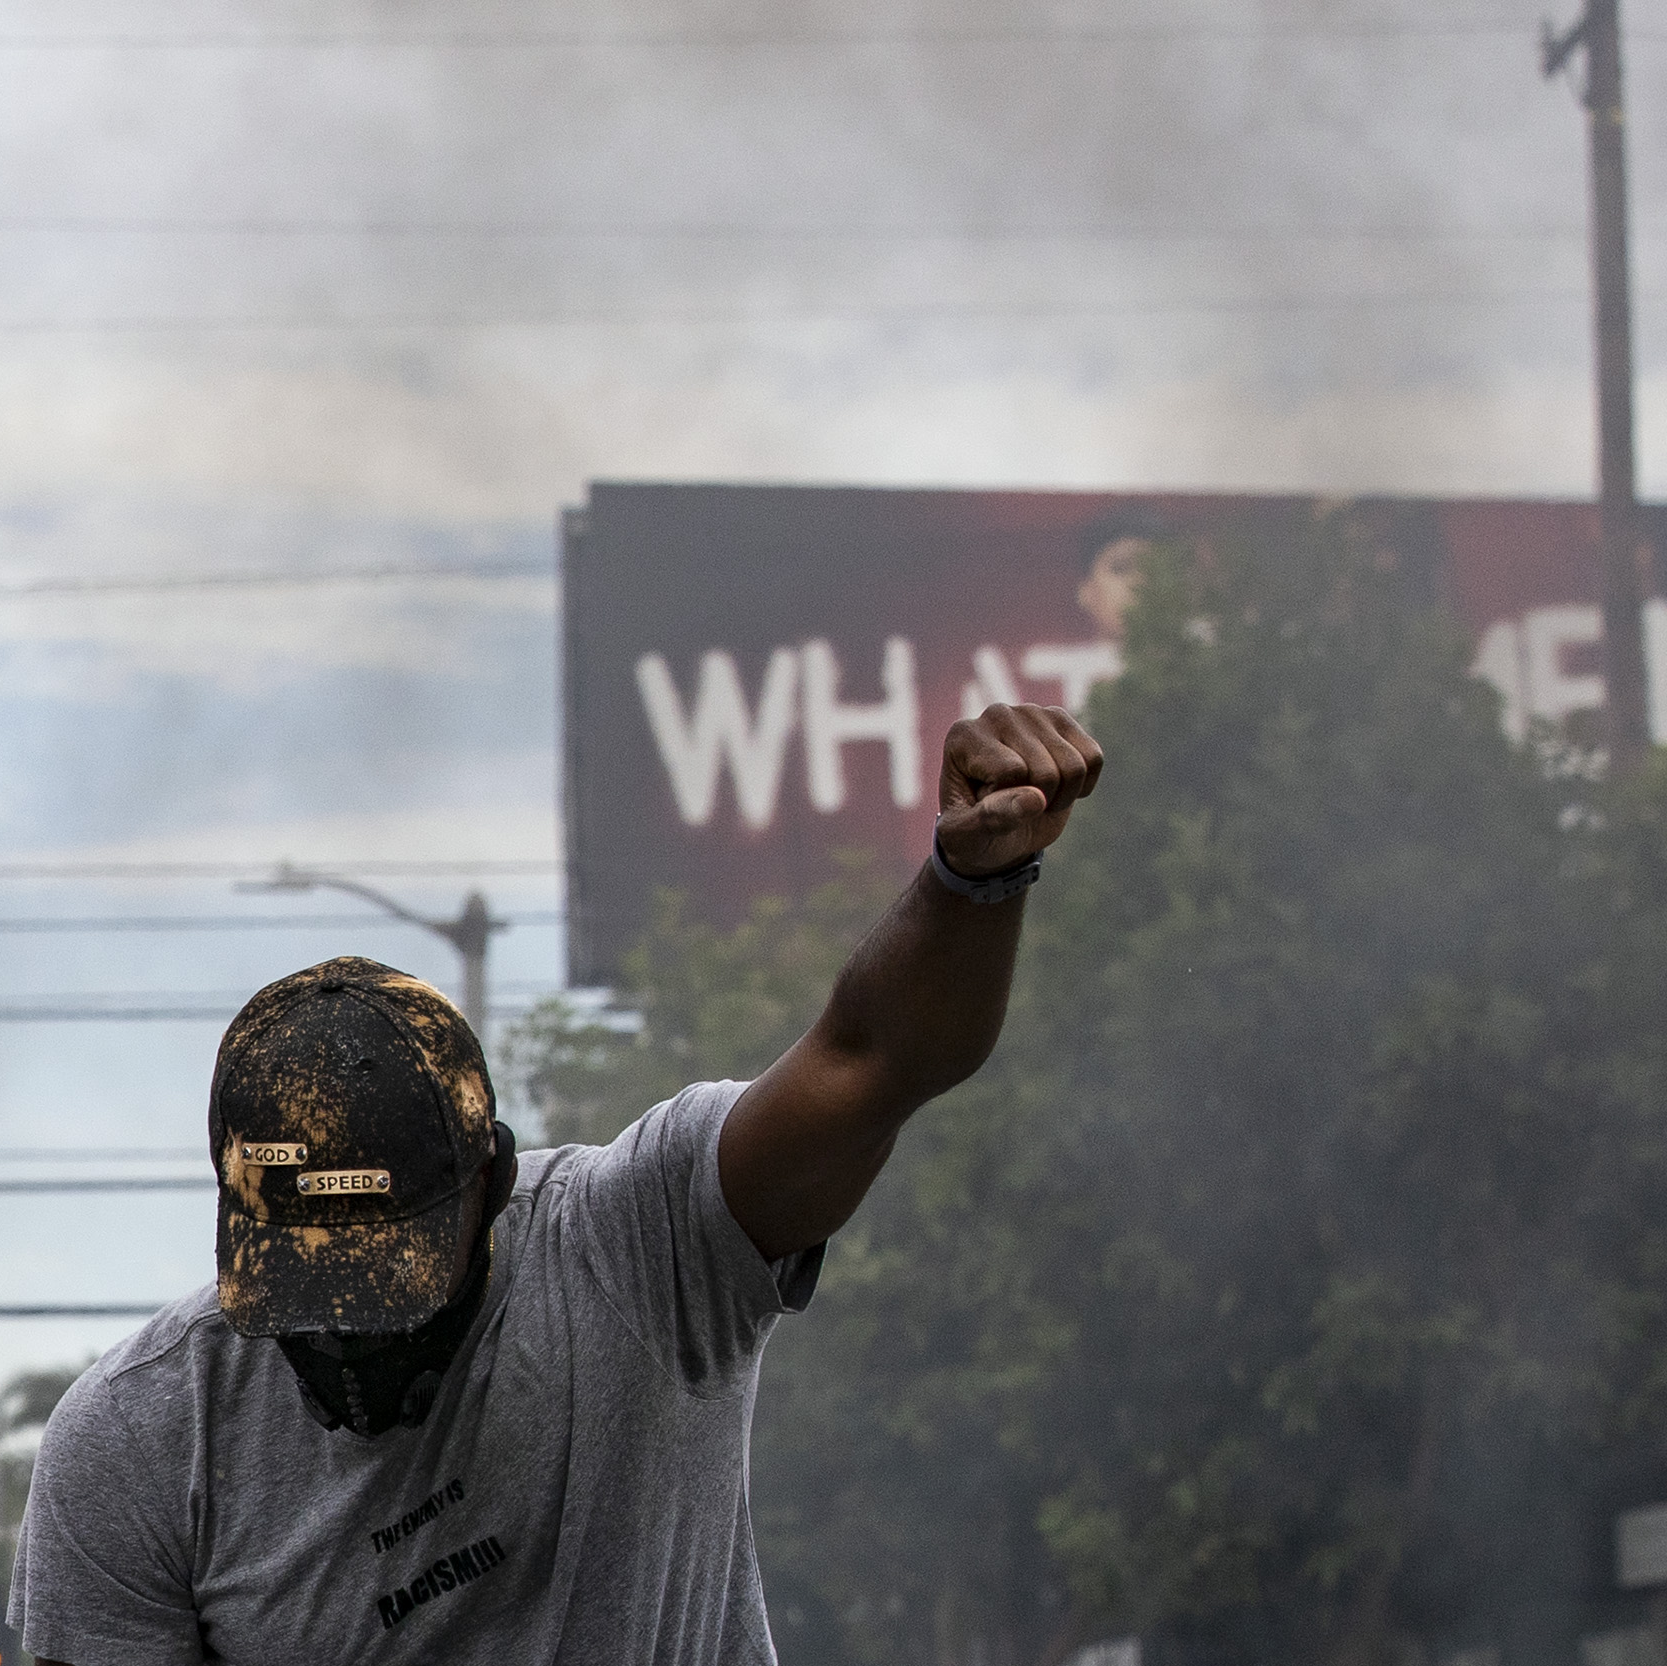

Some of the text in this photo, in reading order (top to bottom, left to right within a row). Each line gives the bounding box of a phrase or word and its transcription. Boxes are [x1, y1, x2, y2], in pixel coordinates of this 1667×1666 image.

[255, 1148, 289, 1163] GOD
[317, 1175, 374, 1191] SPEED
[371, 1478, 465, 1554] THE ENEMY IS
